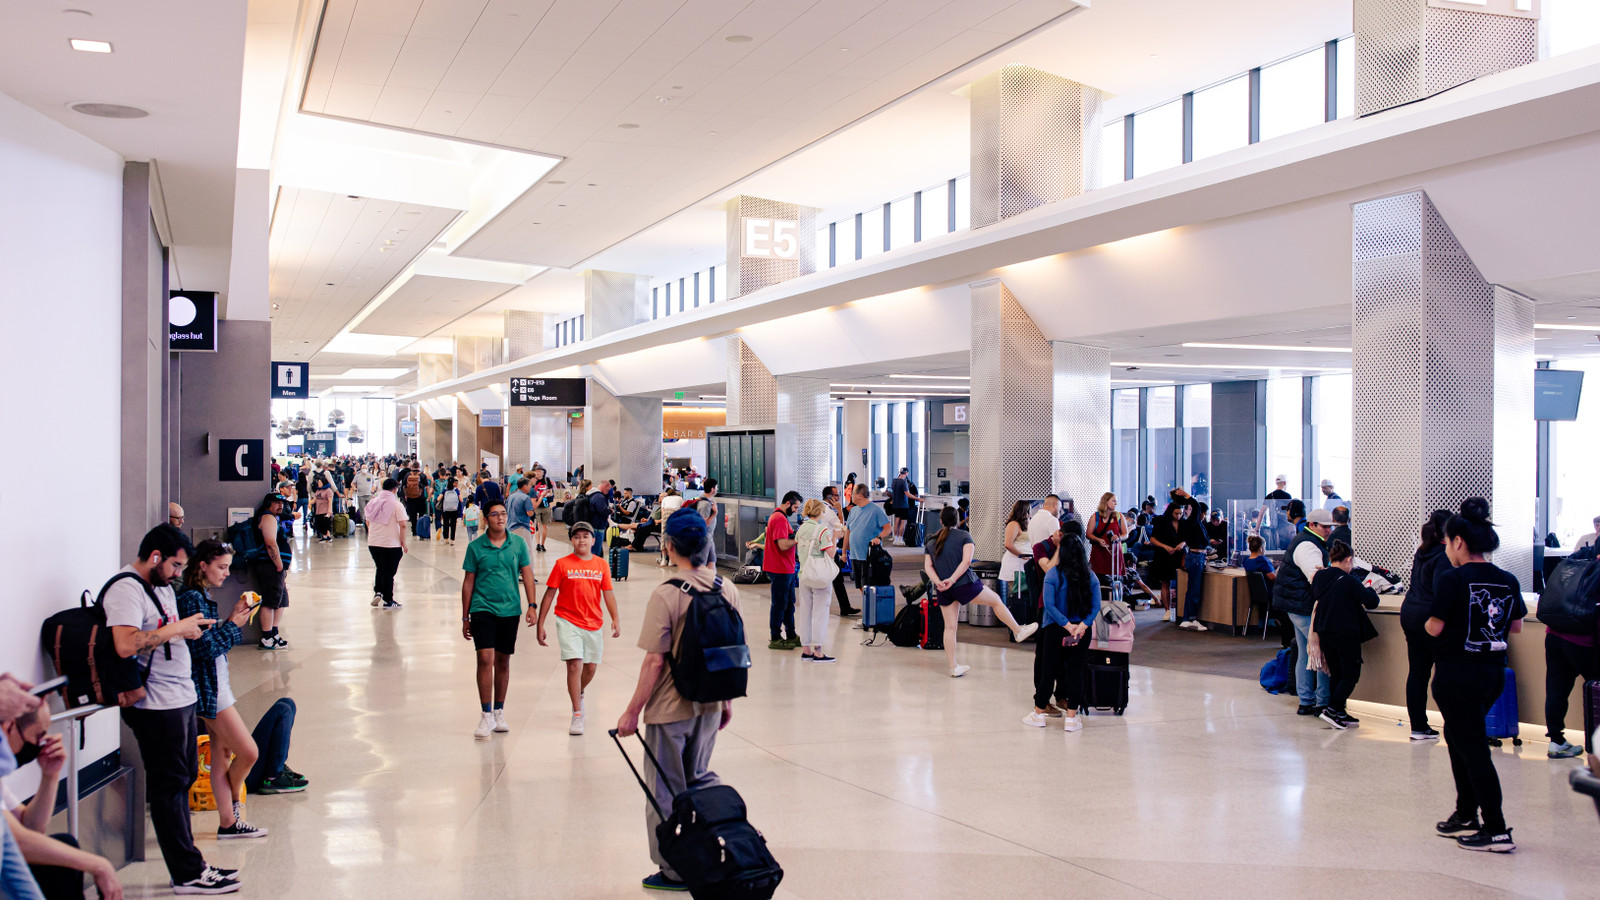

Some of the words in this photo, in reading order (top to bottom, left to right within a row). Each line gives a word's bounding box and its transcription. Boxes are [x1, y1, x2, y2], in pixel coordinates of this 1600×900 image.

[746, 219, 797, 258] E5
[190, 331, 203, 340] hut
[954, 405, 967, 422] E5
[673, 430, 693, 438] BAR
[697, 430, 704, 438] &
[568, 569, 602, 577] NAUTICA
[1492, 834, 1510, 842] HOKA
